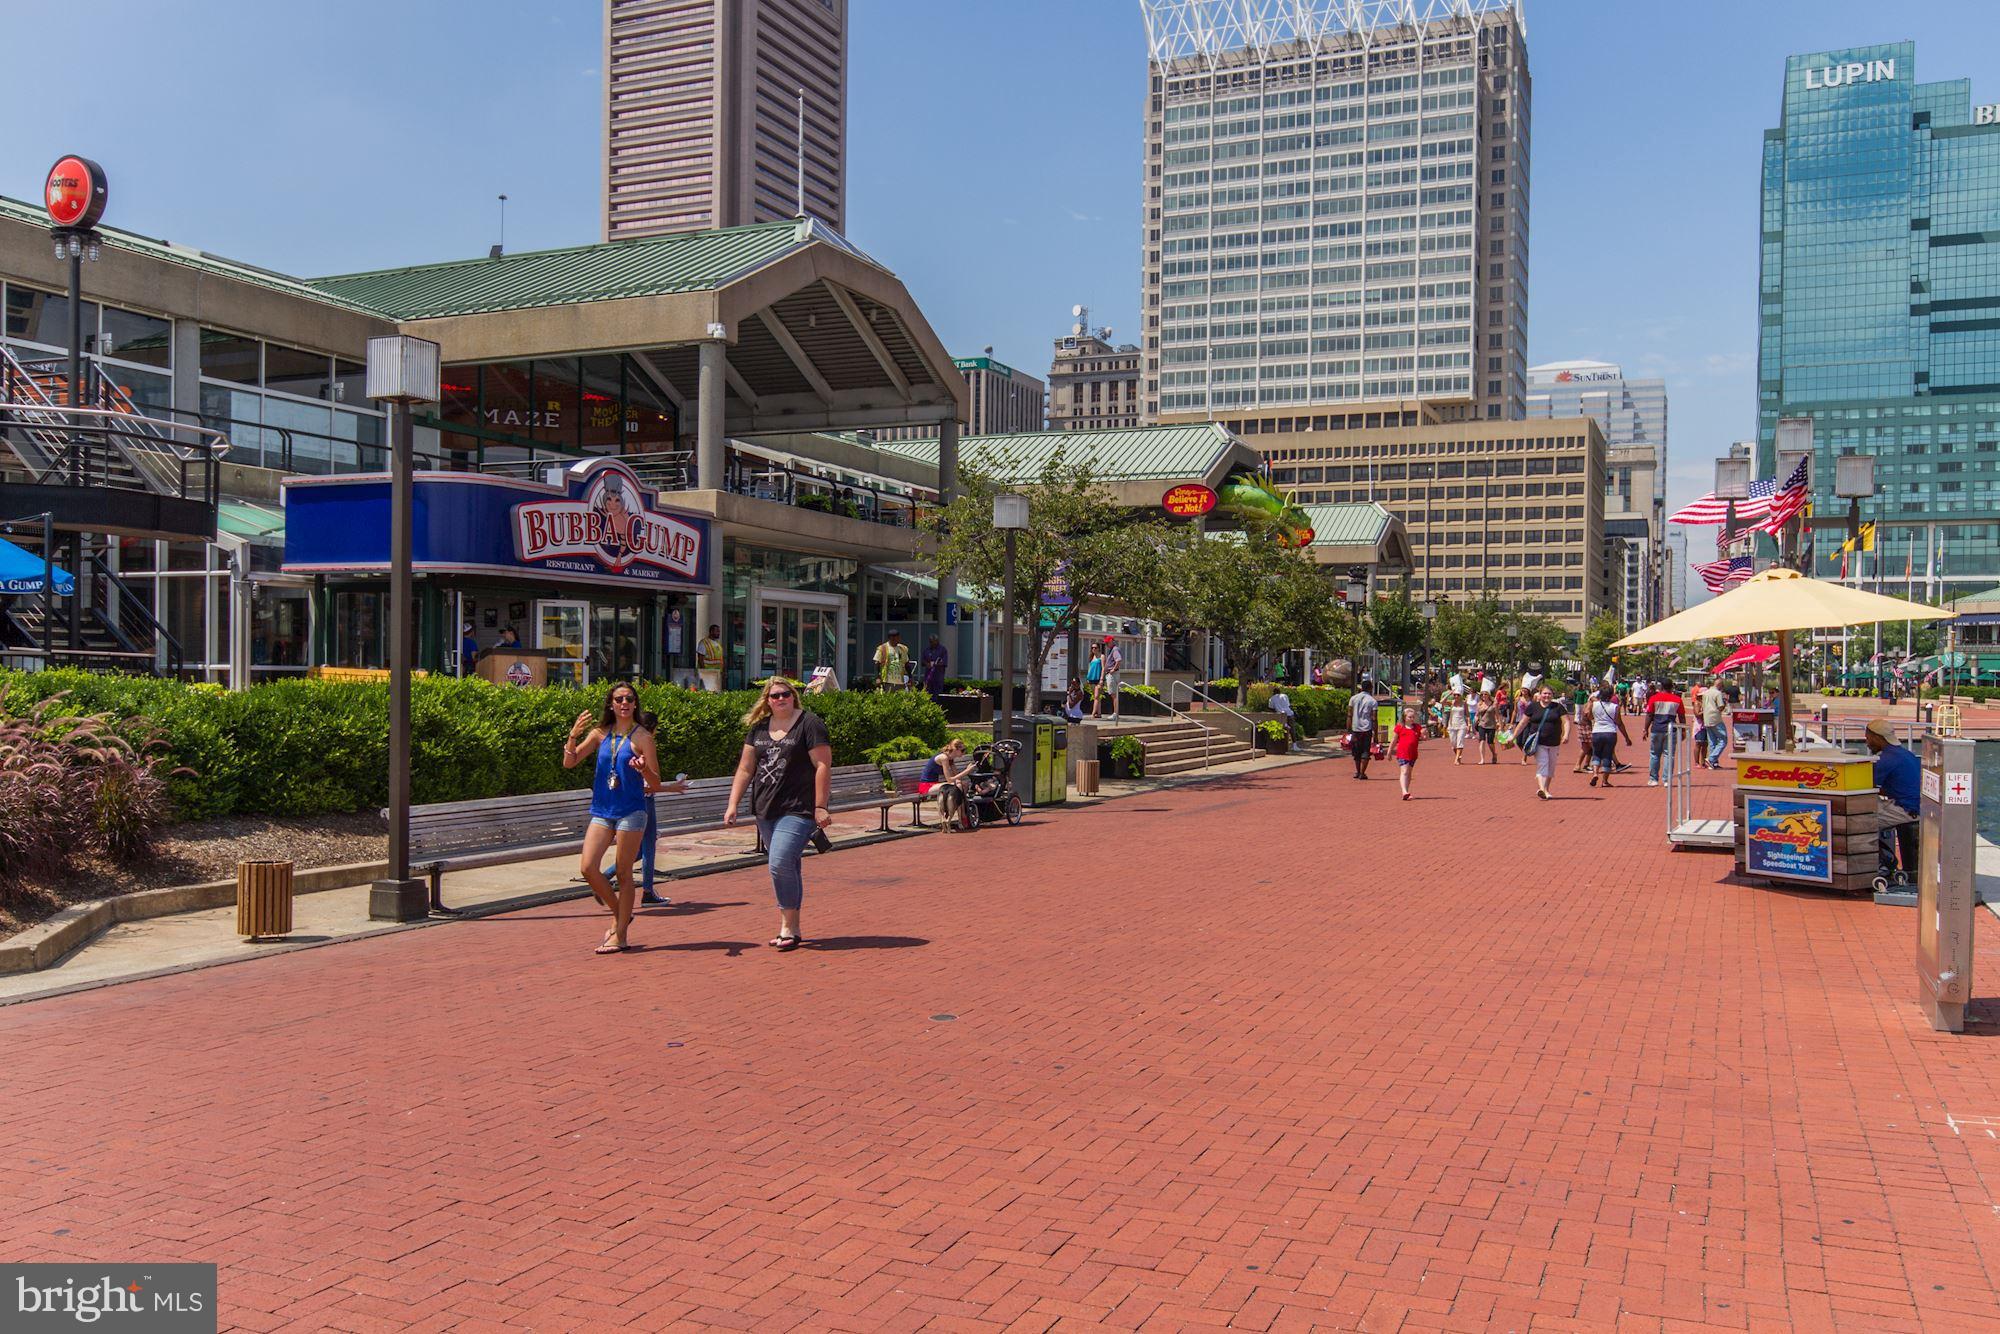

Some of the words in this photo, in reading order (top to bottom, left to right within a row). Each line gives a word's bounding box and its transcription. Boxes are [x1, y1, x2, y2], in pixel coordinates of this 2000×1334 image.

[1806, 58, 1895, 90] LUPIN
[473, 407, 560, 429] MAZE
[590, 406, 639, 428] THEAER
[1168, 494, 1198, 505] Believe
[1199, 494, 1208, 504] It
[1173, 505, 1183, 513] or
[523, 509, 620, 555] BUBBA
[624, 514, 696, 567] GUMP
[546, 559, 596, 573] RESTAURANT
[624, 568, 630, 576] &
[631, 569, 660, 579] MARKET
[8, 580, 44, 590] GUMP
[1743, 765, 1825, 787] Seadog
[1754, 828, 1812, 848] Seadog
[1767, 851, 1804, 863] Sightseeing
[1762, 859, 1797, 870] Speedboat
[1798, 863, 1816, 872] Tours
